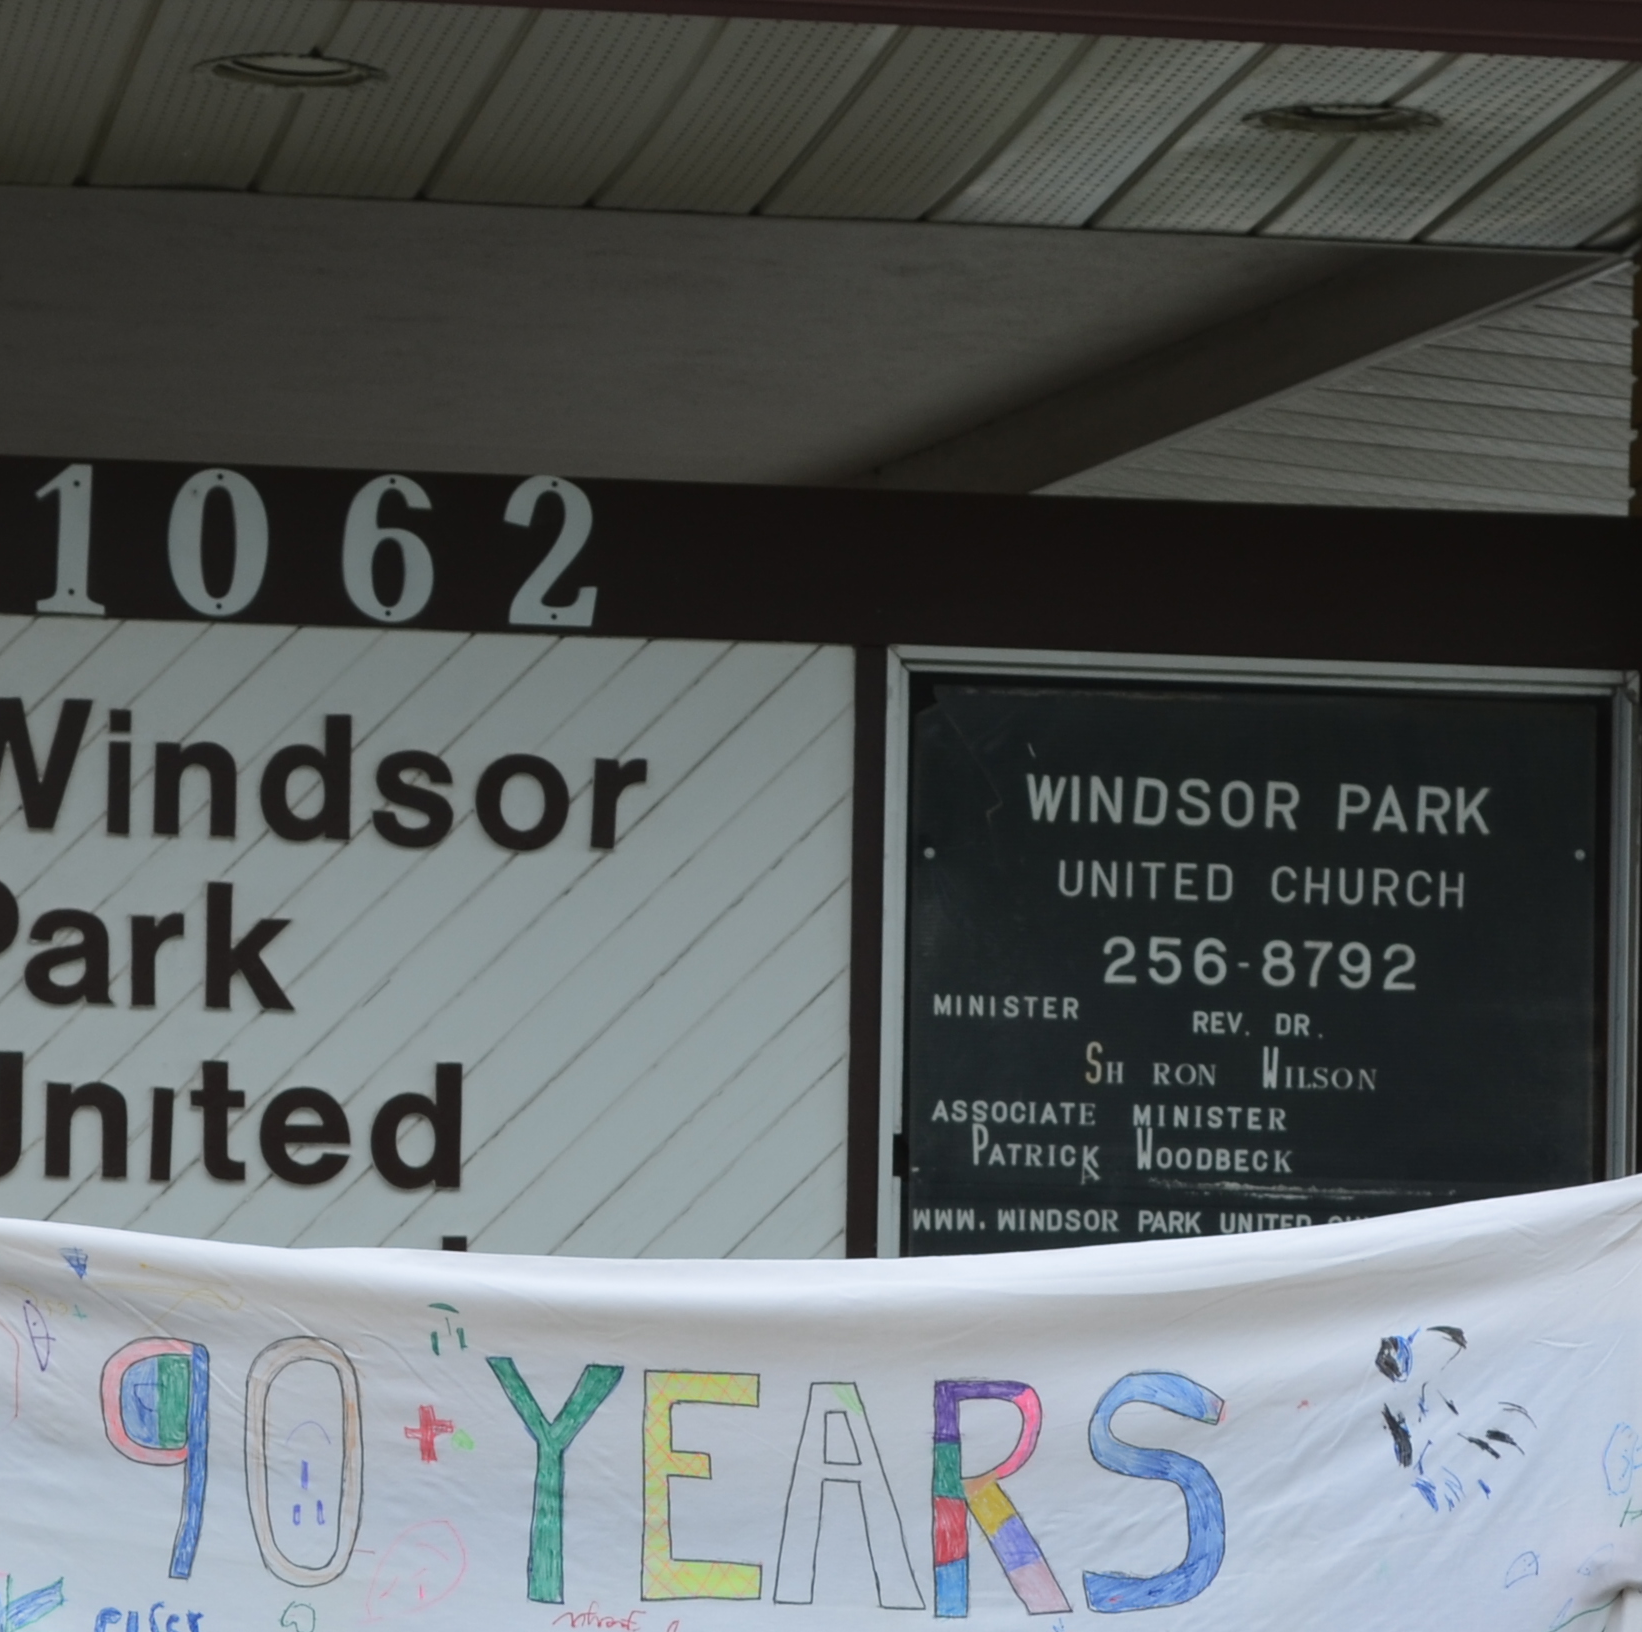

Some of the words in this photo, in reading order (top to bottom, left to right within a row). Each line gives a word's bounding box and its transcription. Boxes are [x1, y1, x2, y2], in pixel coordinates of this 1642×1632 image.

[35, 463, 599, 628] 1062
[1026, 773, 1300, 831] WINDSOR
[1337, 785, 1492, 835] PARK
[1057, 860, 1234, 902] UNITED
[1270, 866, 1466, 908] CHURCH
[1102, 935, 1418, 992] 256-8792
[933, 993, 1079, 1019] MINISTER
[1192, 1010, 1251, 1036] REV.
[1275, 1013, 1325, 1039] DR.
[931, 1099, 1097, 1127] ASSOCIATE
[1133, 1103, 1288, 1131] MINISTER
[971, 1122, 1101, 1168] PATRICK
[1136, 1126, 1293, 1173] WOODBECK
[997, 1207, 1120, 1233] WINDSOR
[1137, 1210, 1203, 1235] PARK
[101, 1335, 364, 1587] 90
[485, 1355, 1226, 1618] YEARS
